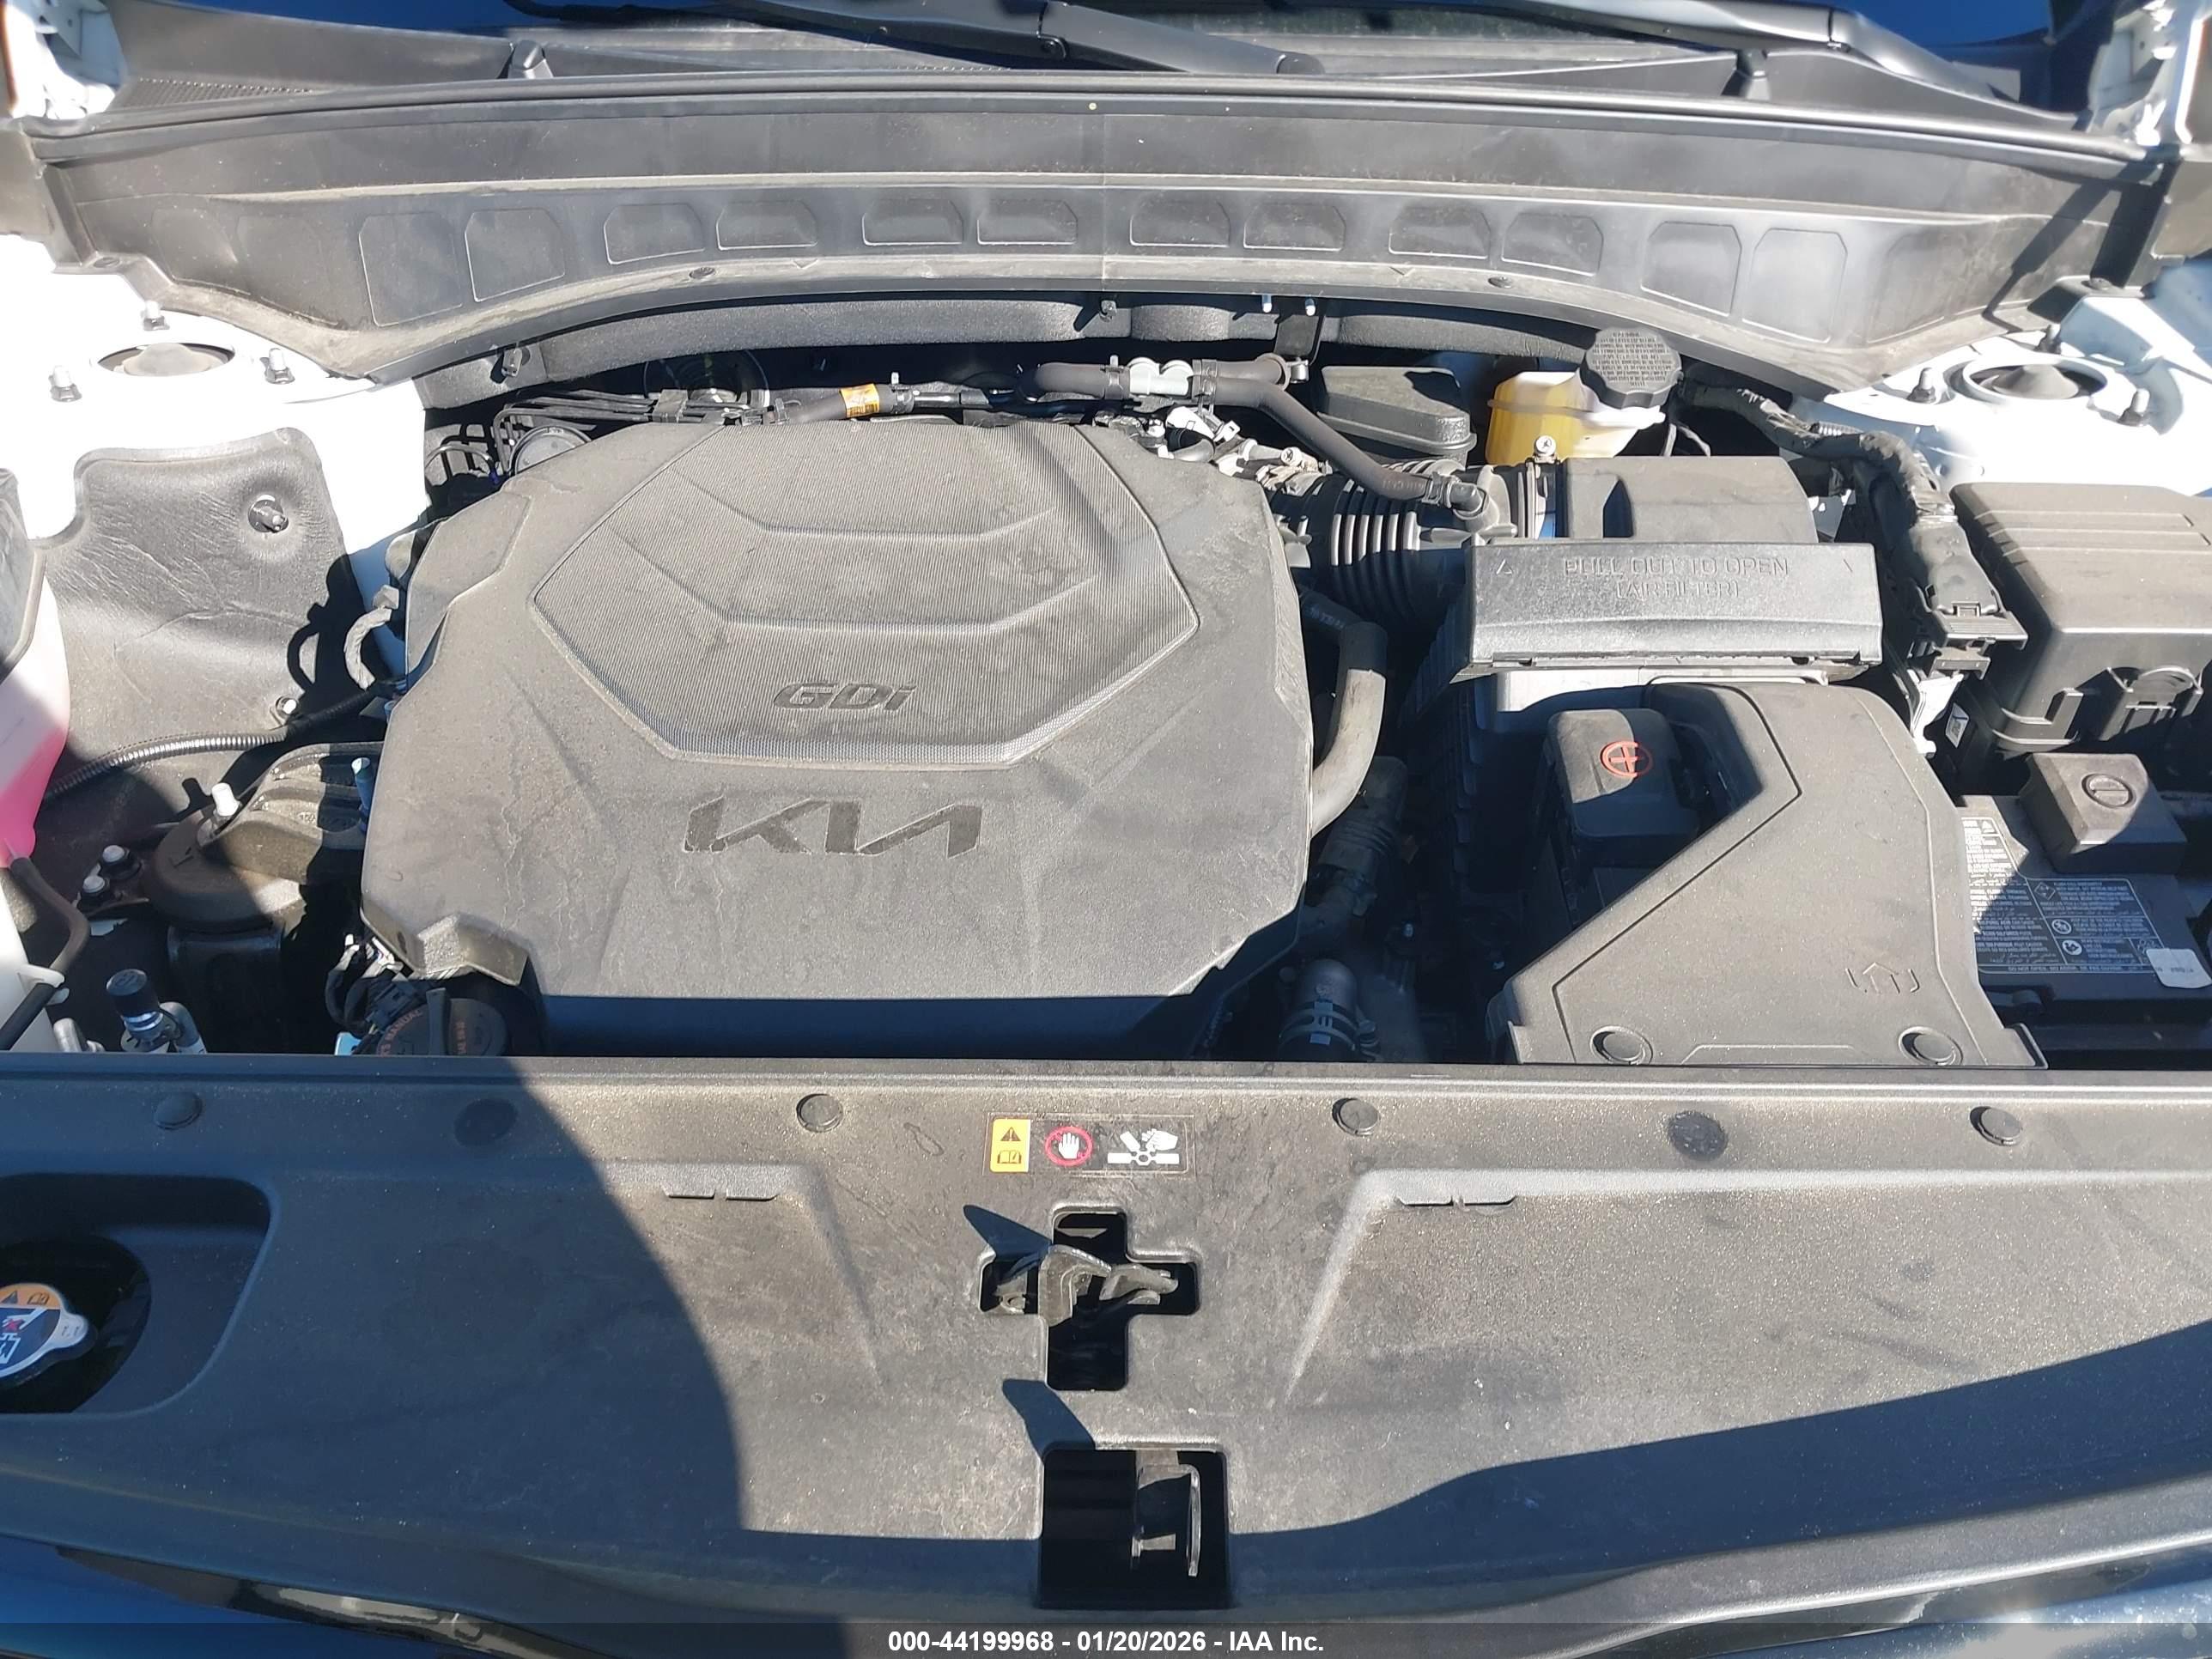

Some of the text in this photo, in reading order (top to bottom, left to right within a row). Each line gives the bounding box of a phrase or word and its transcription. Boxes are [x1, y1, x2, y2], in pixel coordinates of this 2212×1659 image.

[1563, 556, 1789, 576] PULL OUT TO OPEN
[773, 682, 917, 712] GDi
[684, 795, 983, 858] KIA
